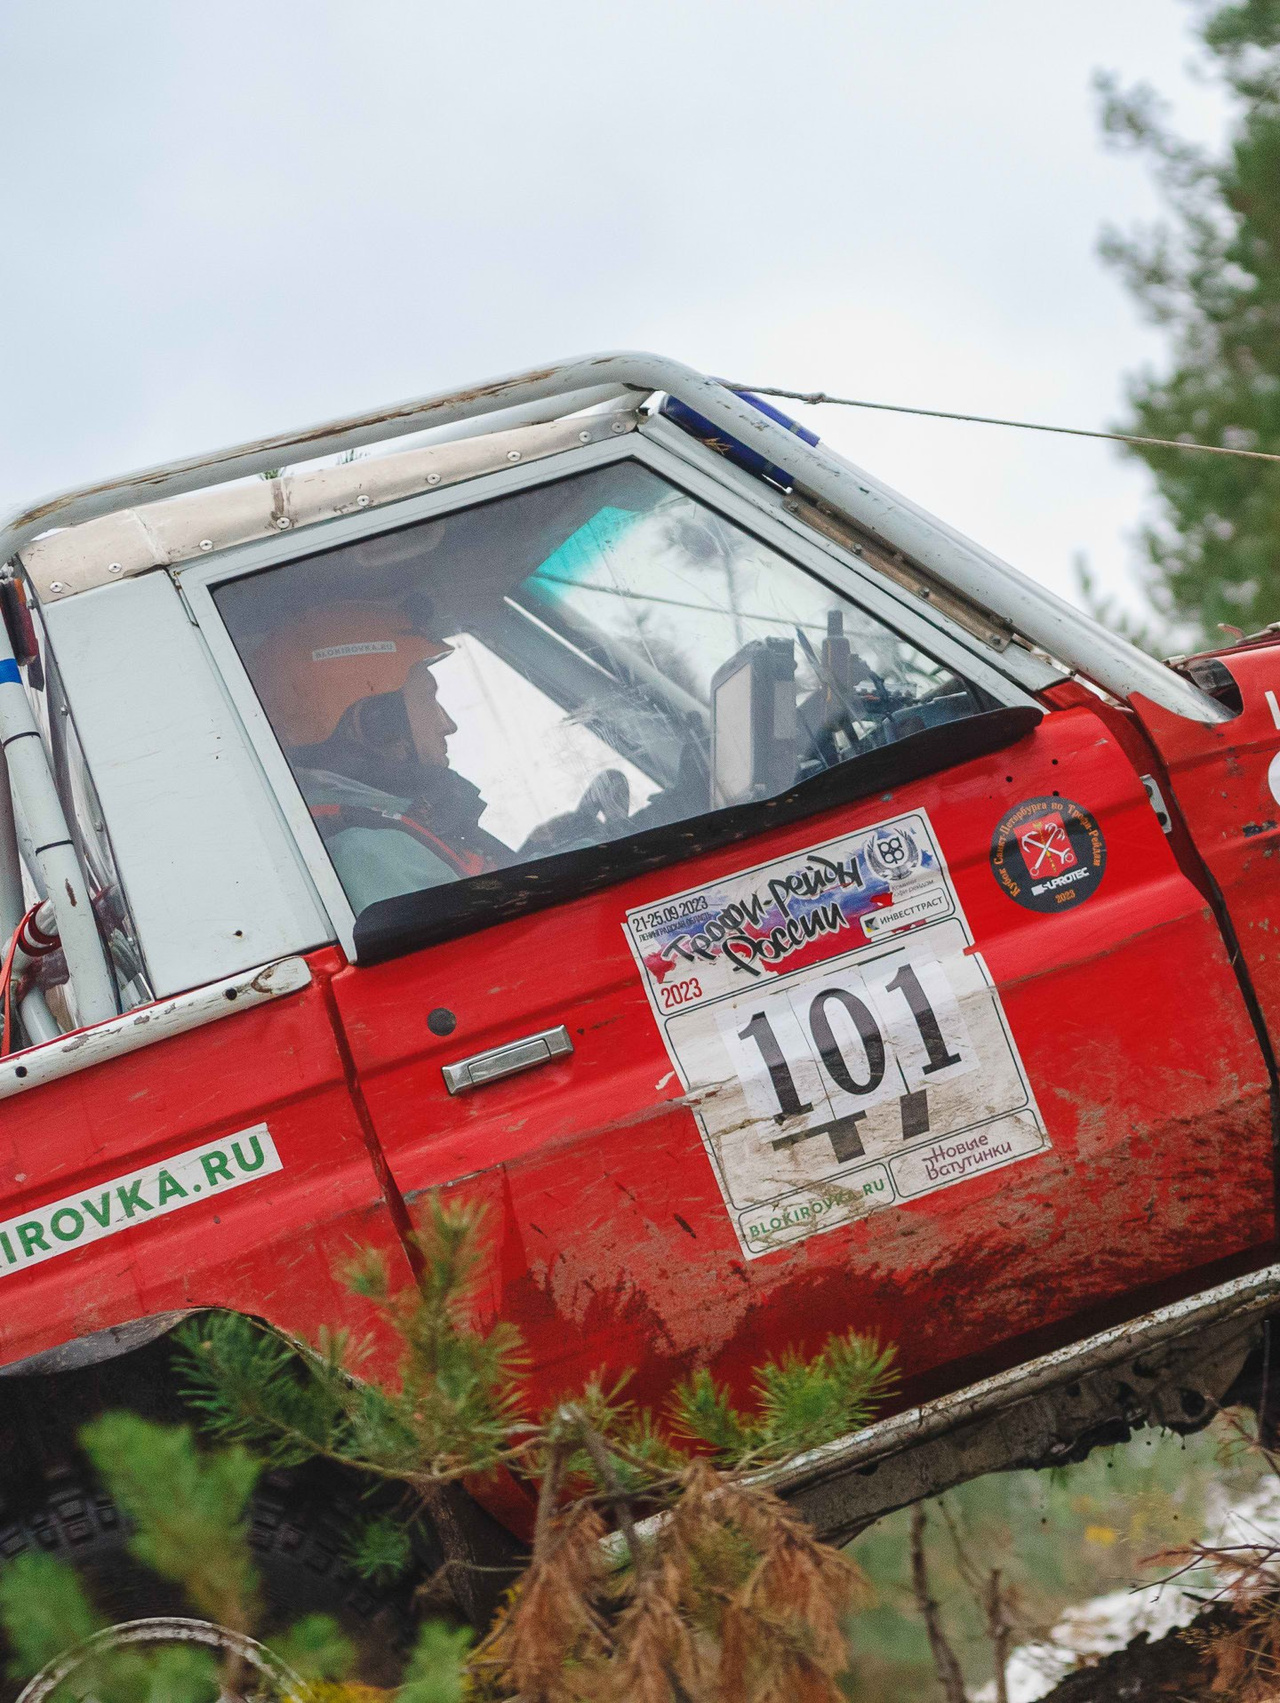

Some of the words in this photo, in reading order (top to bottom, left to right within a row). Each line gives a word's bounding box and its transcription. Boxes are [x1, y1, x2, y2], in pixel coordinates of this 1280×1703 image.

[999, 867, 1021, 897] Кубок
[1051, 802, 1064, 811] по
[1040, 866, 1091, 891] SUPROTEC
[632, 895, 709, 933] 21-25.09.2023
[879, 896, 943, 925] ИНВЕСТТРАСТ
[1055, 889, 1076, 904] 2023
[639, 917, 686, 943] ЛЕНИНГРАДСКАЯ
[660, 977, 703, 1009] 2023
[738, 963, 963, 1125] 101
[922, 1134, 989, 1164] Новые
[925, 1141, 1013, 1181] Ватутинки
[0, 1135, 266, 1268] IROVKA.RU
[749, 1178, 885, 1238] BLOKIROVK.RU
